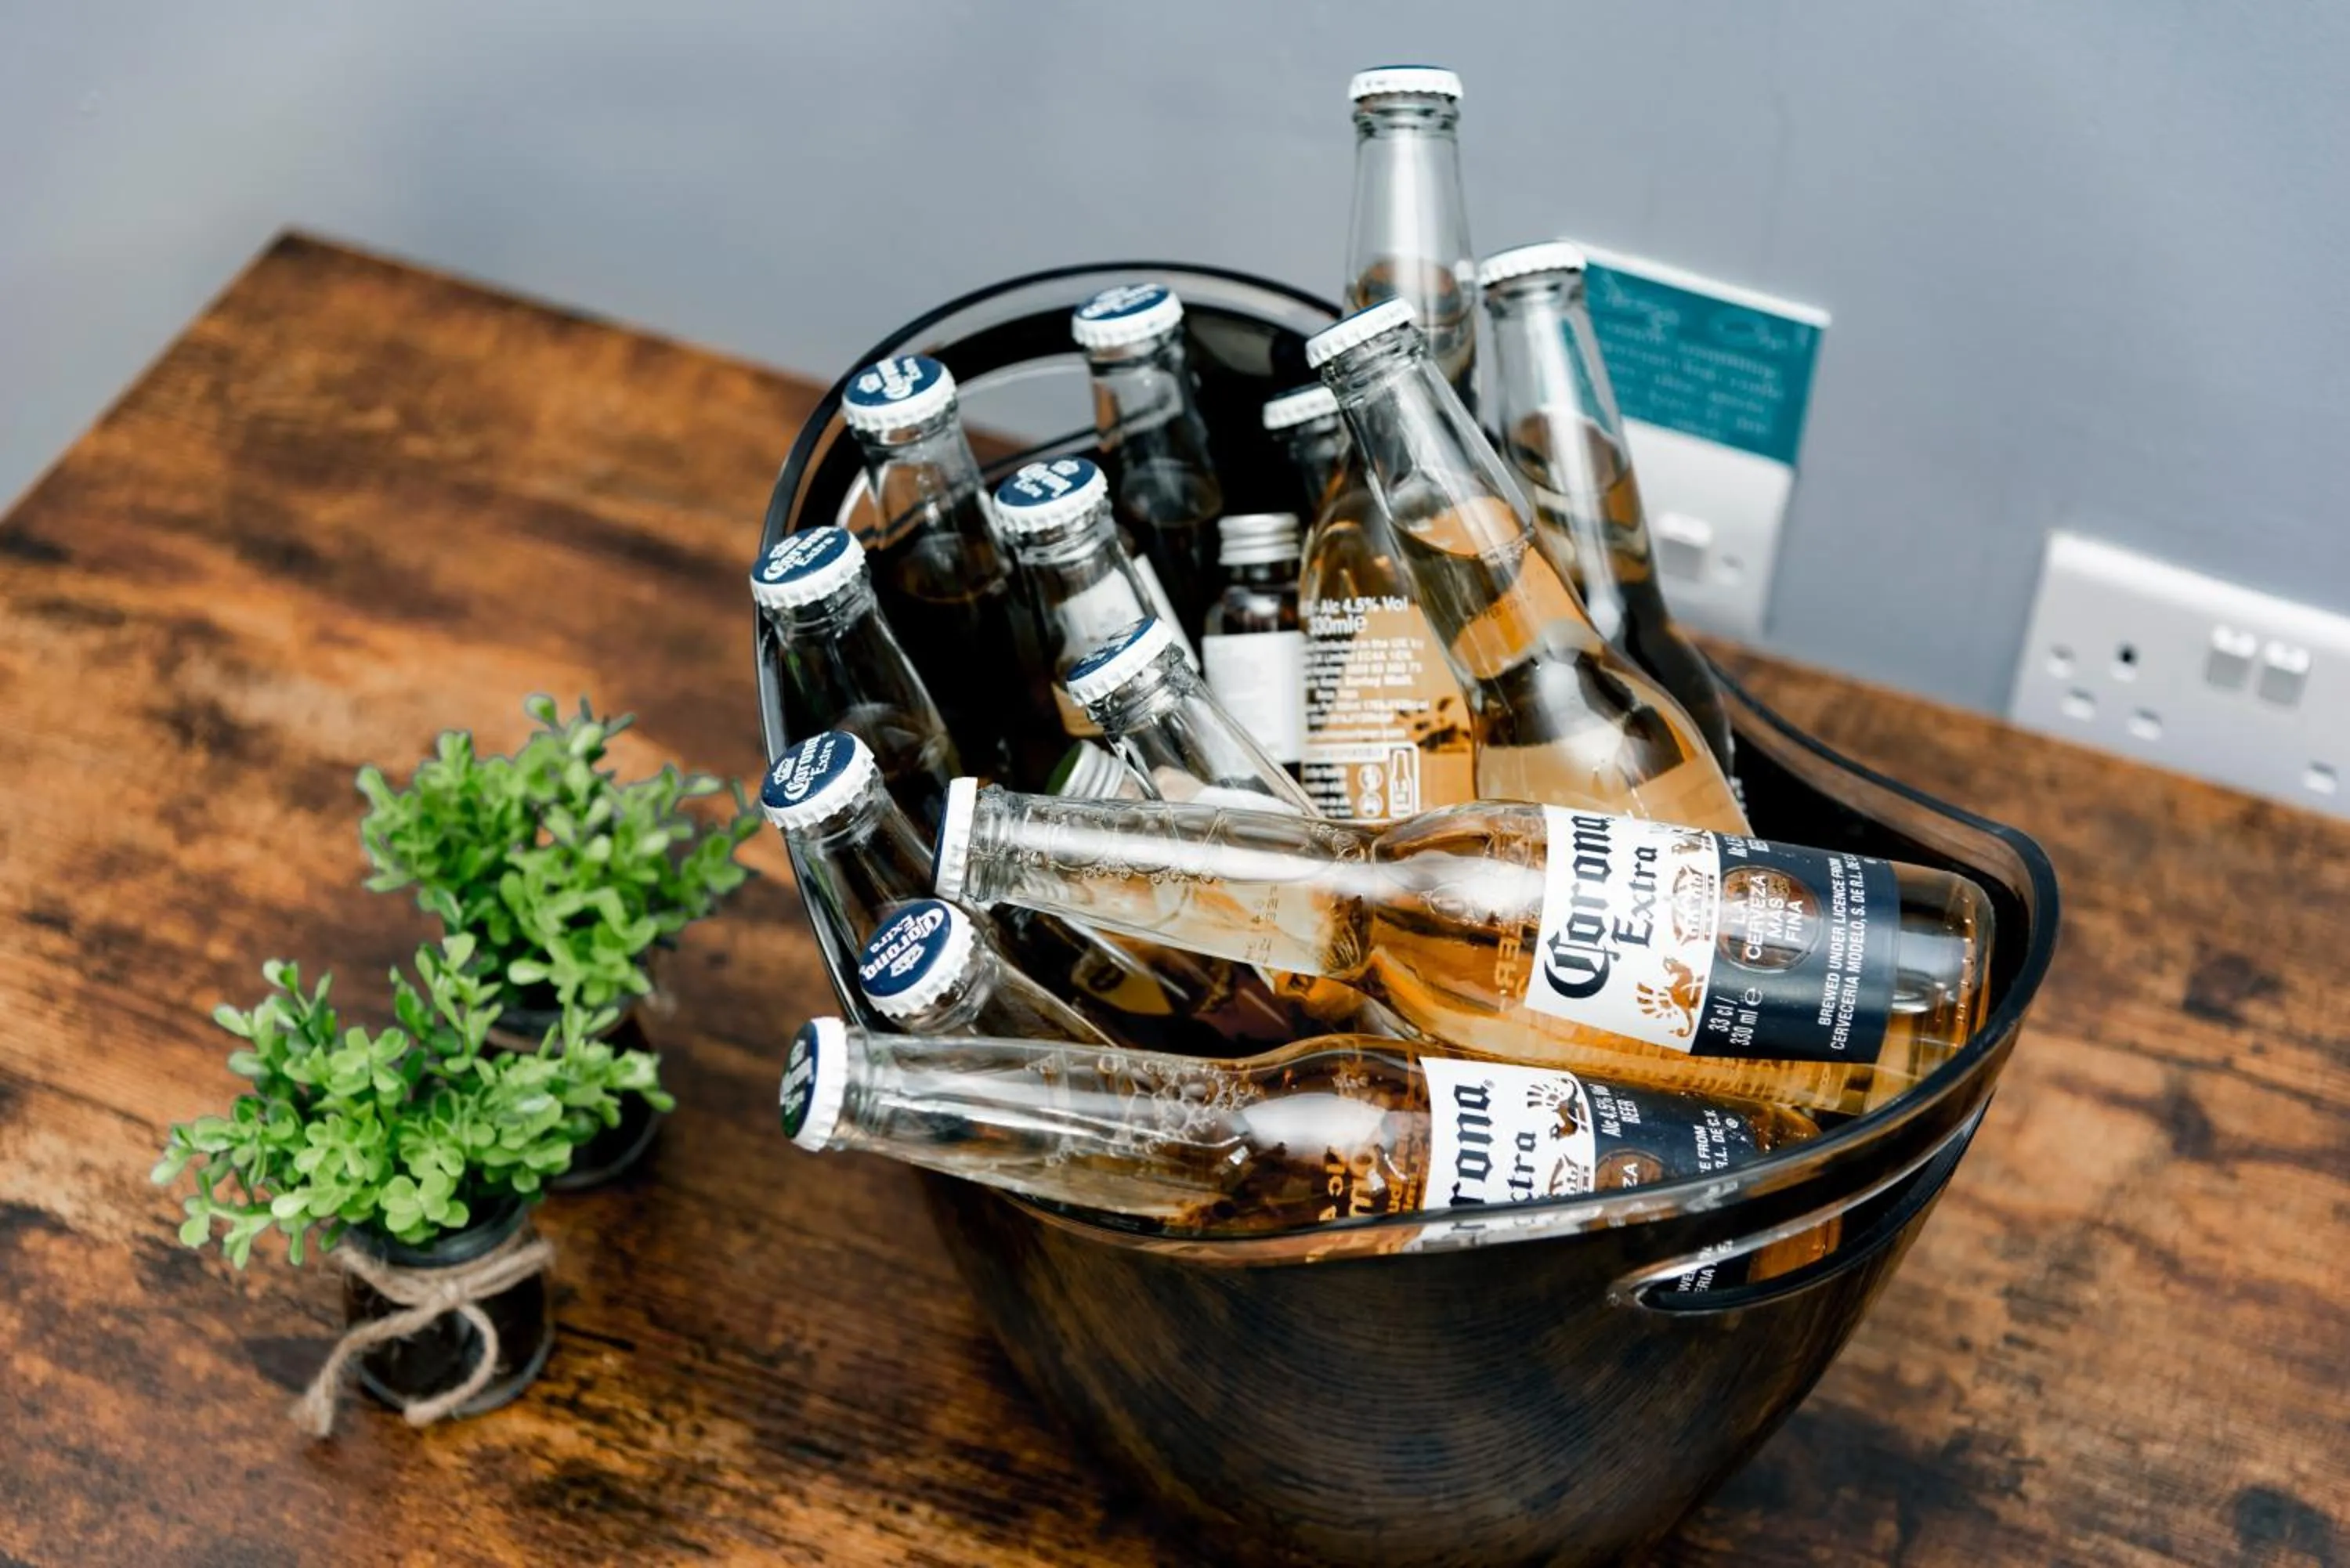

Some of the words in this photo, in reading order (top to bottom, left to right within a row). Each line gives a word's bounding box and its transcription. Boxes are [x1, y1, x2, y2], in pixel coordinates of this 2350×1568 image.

[1382, 595, 1408, 612] Vol
[1544, 815, 1621, 999] Corona
[1611, 847, 1658, 948] Extra
[1730, 900, 1748, 924] LA
[1832, 878, 1846, 923] LICENCE
[1850, 887, 1865, 903] DE
[870, 915, 915, 953] Extra
[1745, 875, 1767, 959] CERVEZA
[1766, 898, 1784, 938] MAS
[1784, 900, 1803, 941] FINA
[859, 908, 944, 980] Corona
[1828, 927, 1846, 970] UNDER
[1846, 919, 1867, 973] MODELO,
[1713, 1004, 1734, 1017] cl
[1737, 1008, 1759, 1025] ml
[1817, 972, 1840, 1026] BREWED
[1830, 976, 1860, 1050] CERVECERIA
[1708, 1017, 1730, 1032] 33
[1729, 1025, 1754, 1046] 330
[1601, 1119, 1622, 1137] Alc
[1616, 1099, 1641, 1124] BEER
[1449, 1084, 1494, 1208] rona
[1693, 1124, 1711, 1159] FROM
[1709, 1128, 1726, 1143] DE
